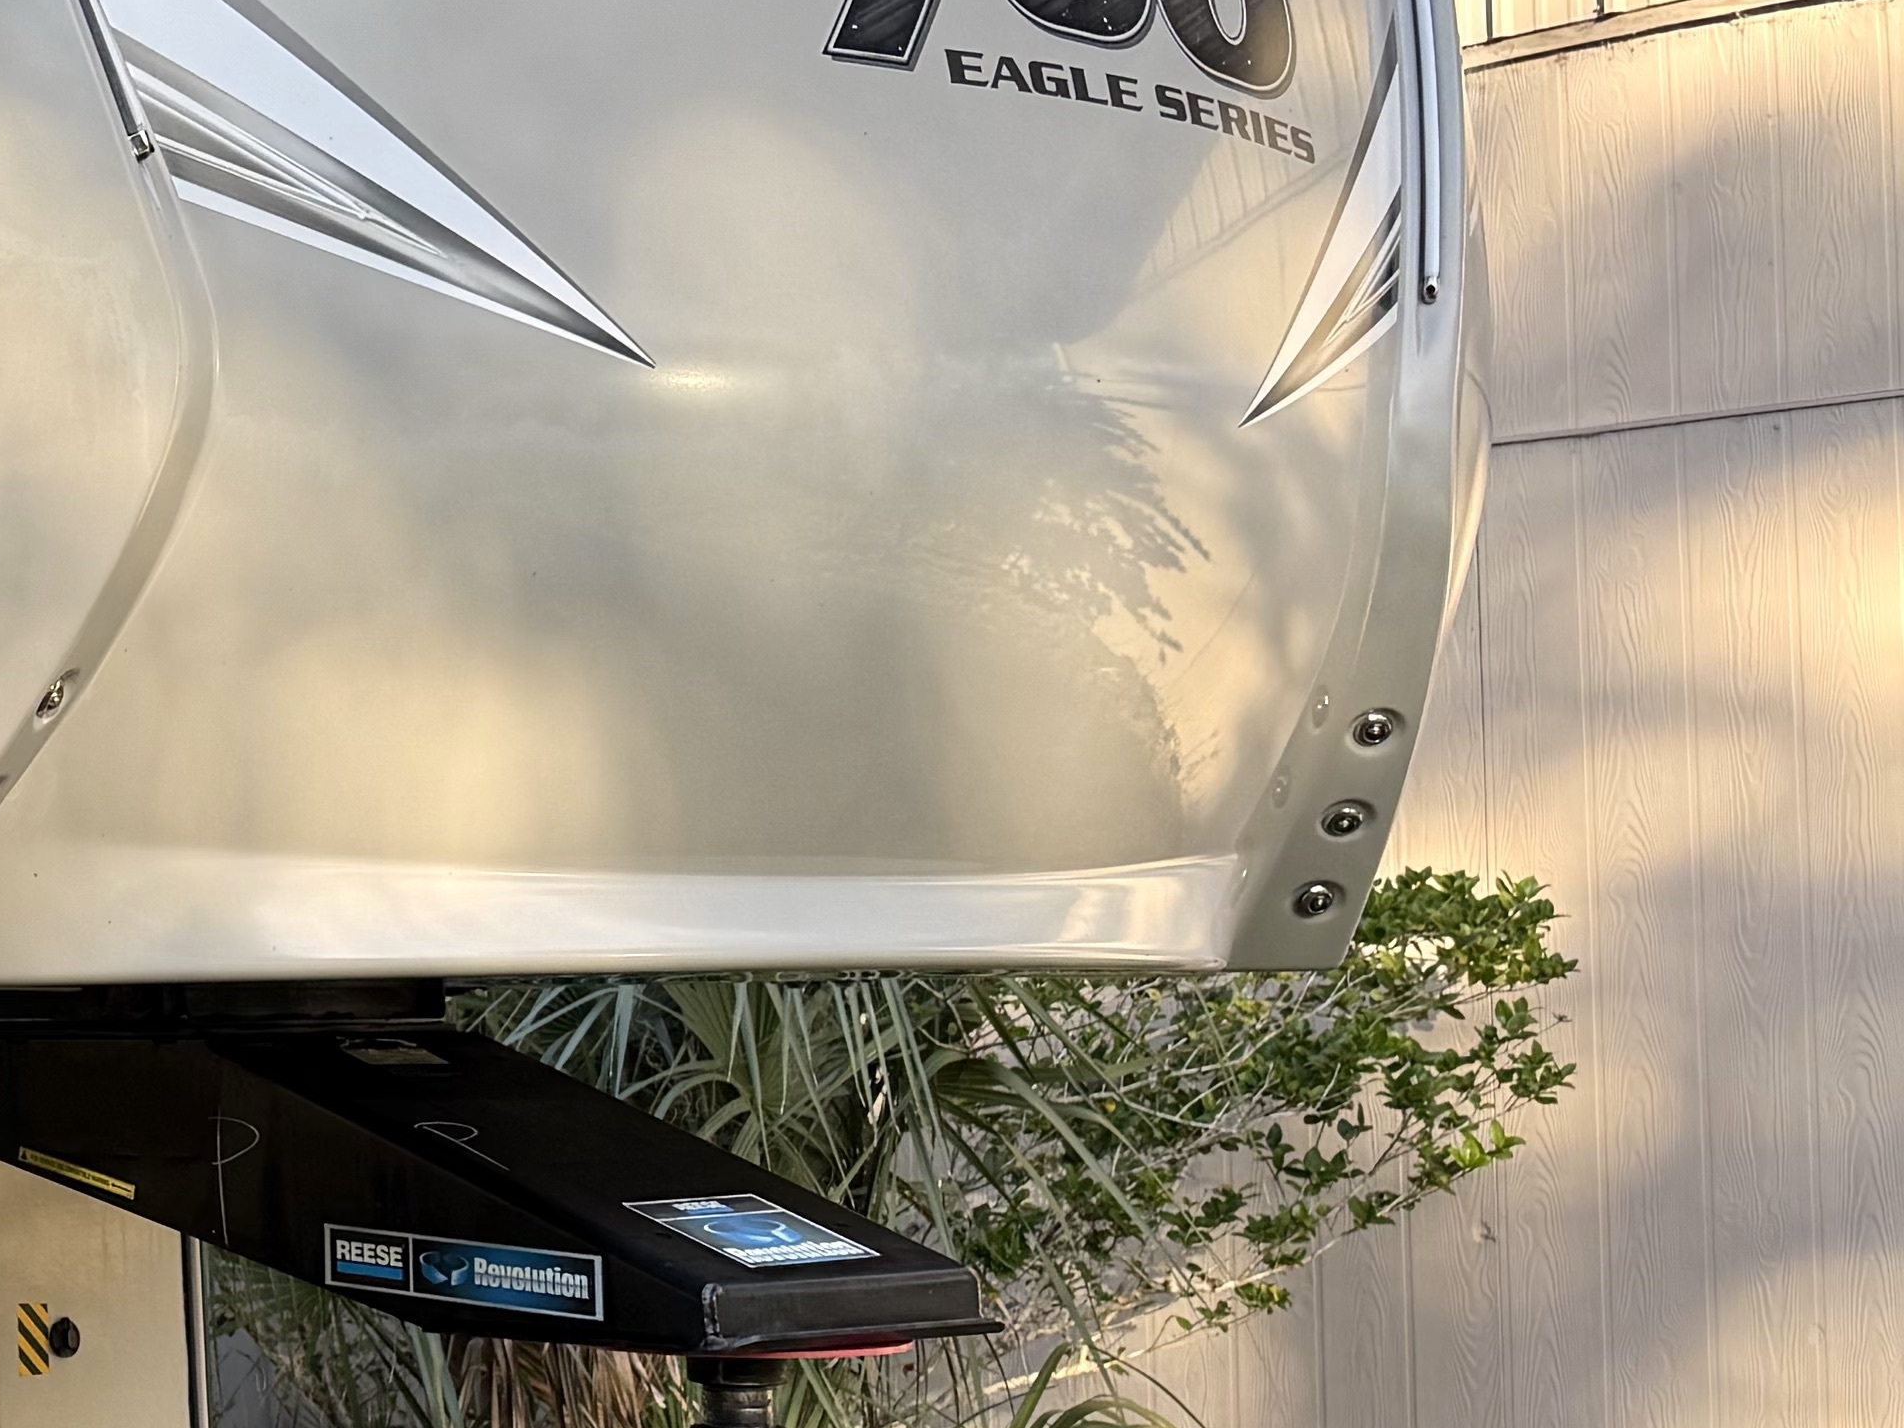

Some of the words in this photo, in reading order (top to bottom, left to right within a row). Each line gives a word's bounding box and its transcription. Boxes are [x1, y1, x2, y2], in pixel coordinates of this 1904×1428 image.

[944, 48, 1143, 112] EAGLE
[1153, 84, 1316, 164] SERIES
[335, 1239, 403, 1268] REESE
[473, 1257, 590, 1300] Revolution
[722, 1240, 865, 1263] Revolution
